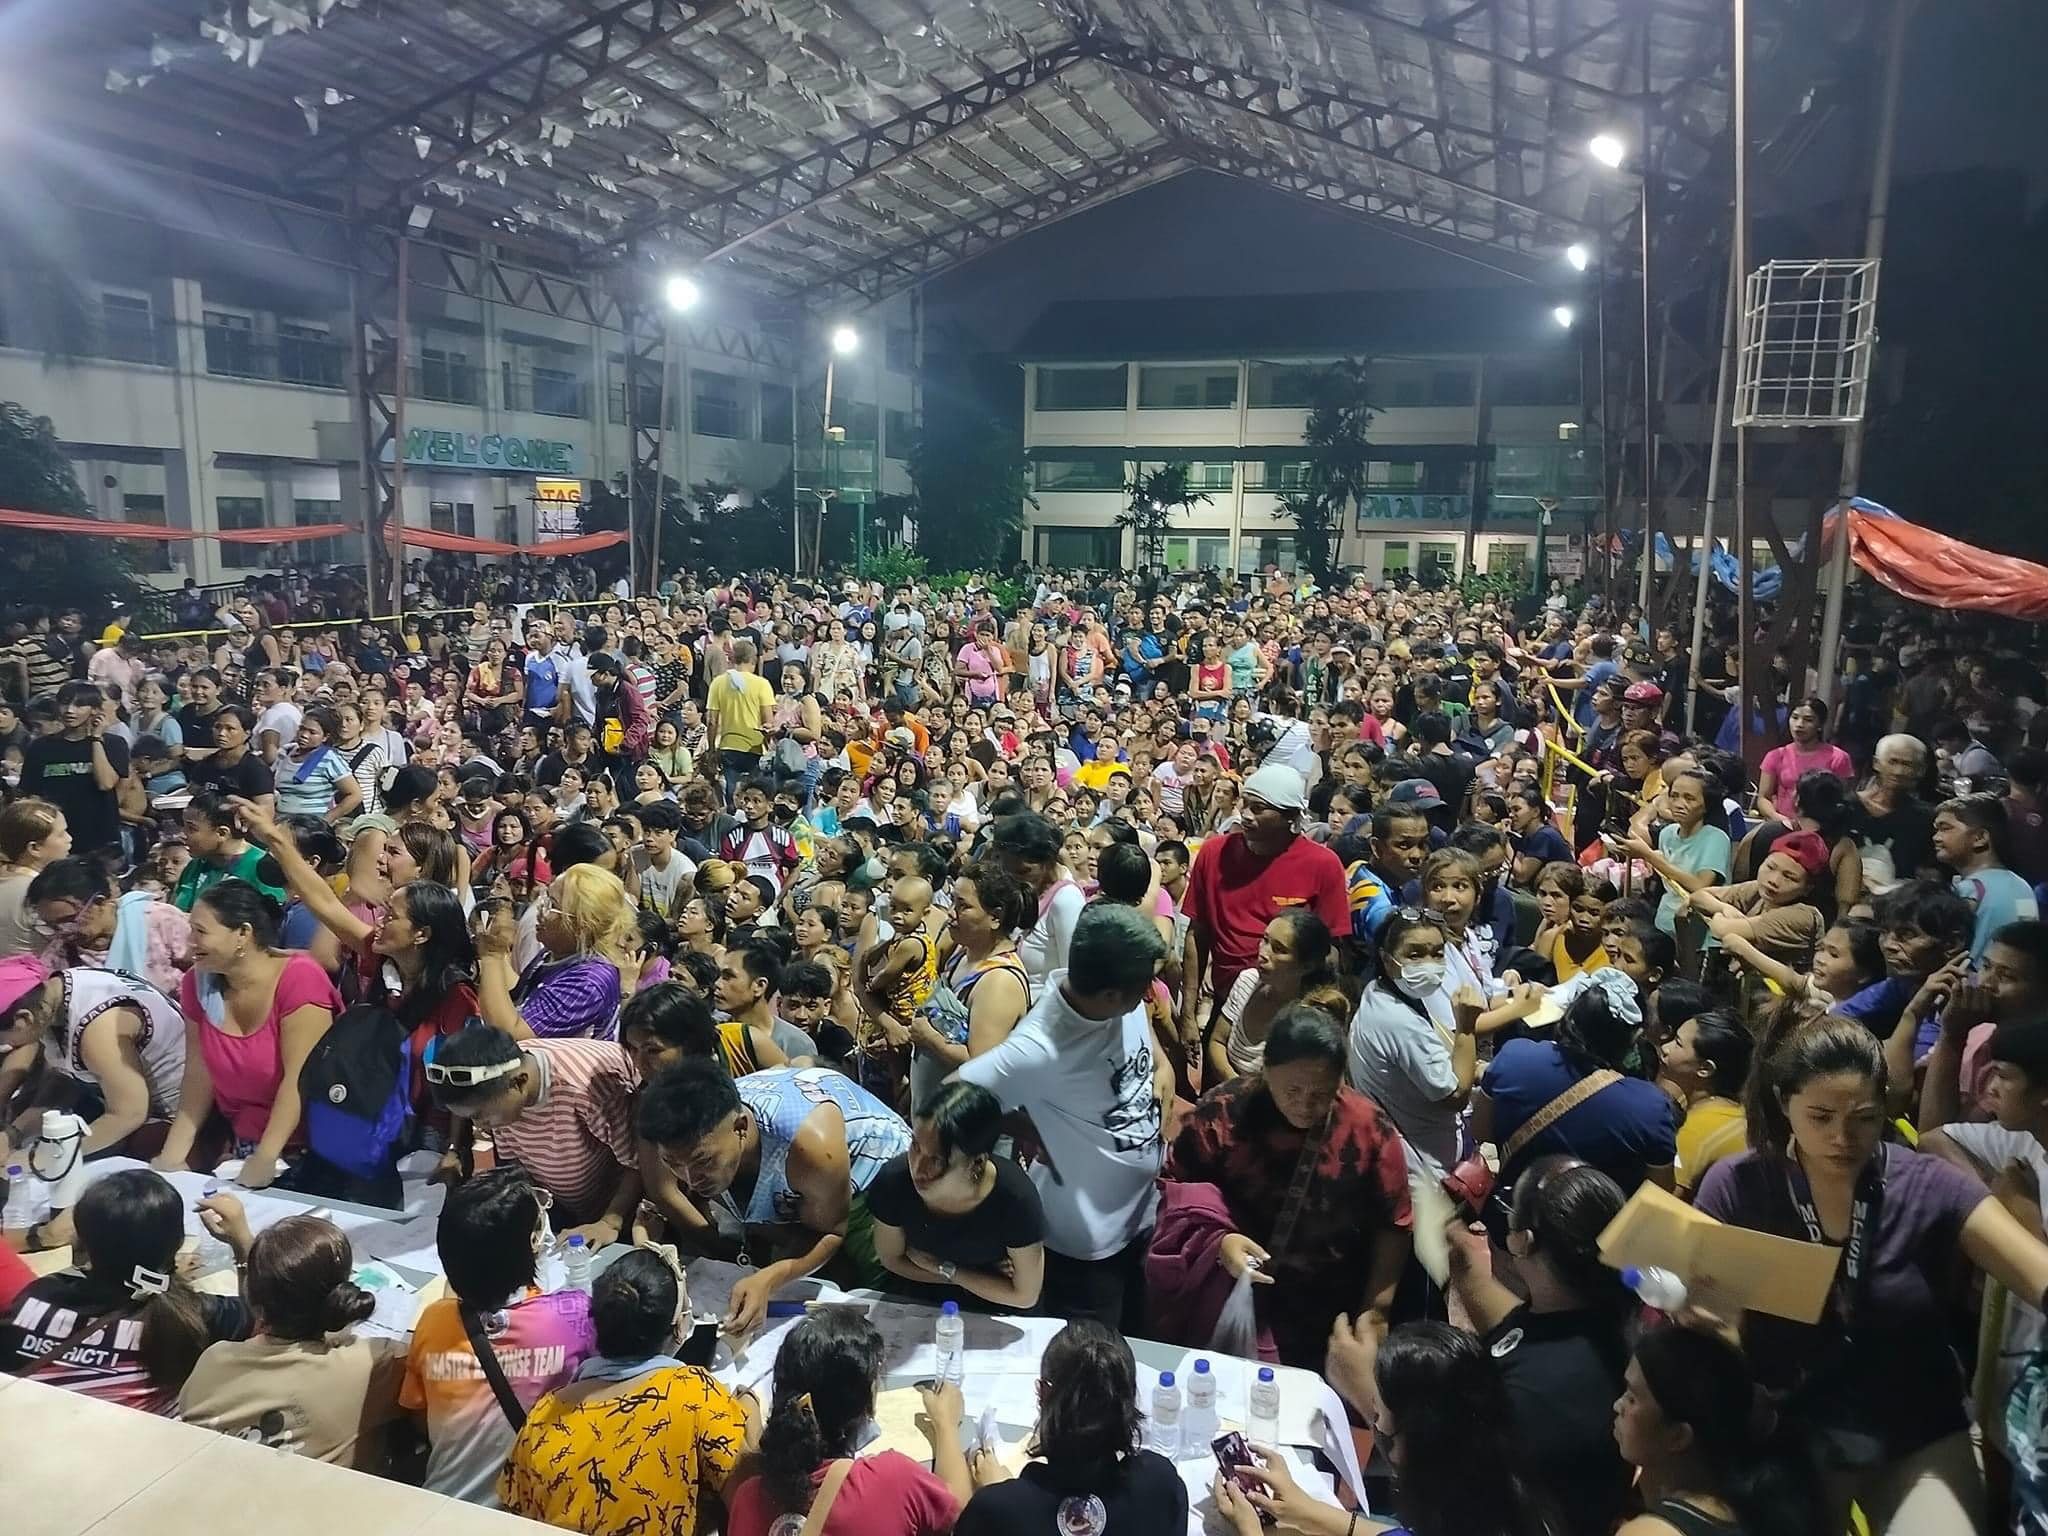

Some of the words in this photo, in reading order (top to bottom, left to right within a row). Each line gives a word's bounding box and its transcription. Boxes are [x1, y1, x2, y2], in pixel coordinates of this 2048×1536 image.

[404, 428, 574, 471] WELCOME
[22, 1334, 109, 1365] DISRICT
[533, 1345, 566, 1376] TEAM
